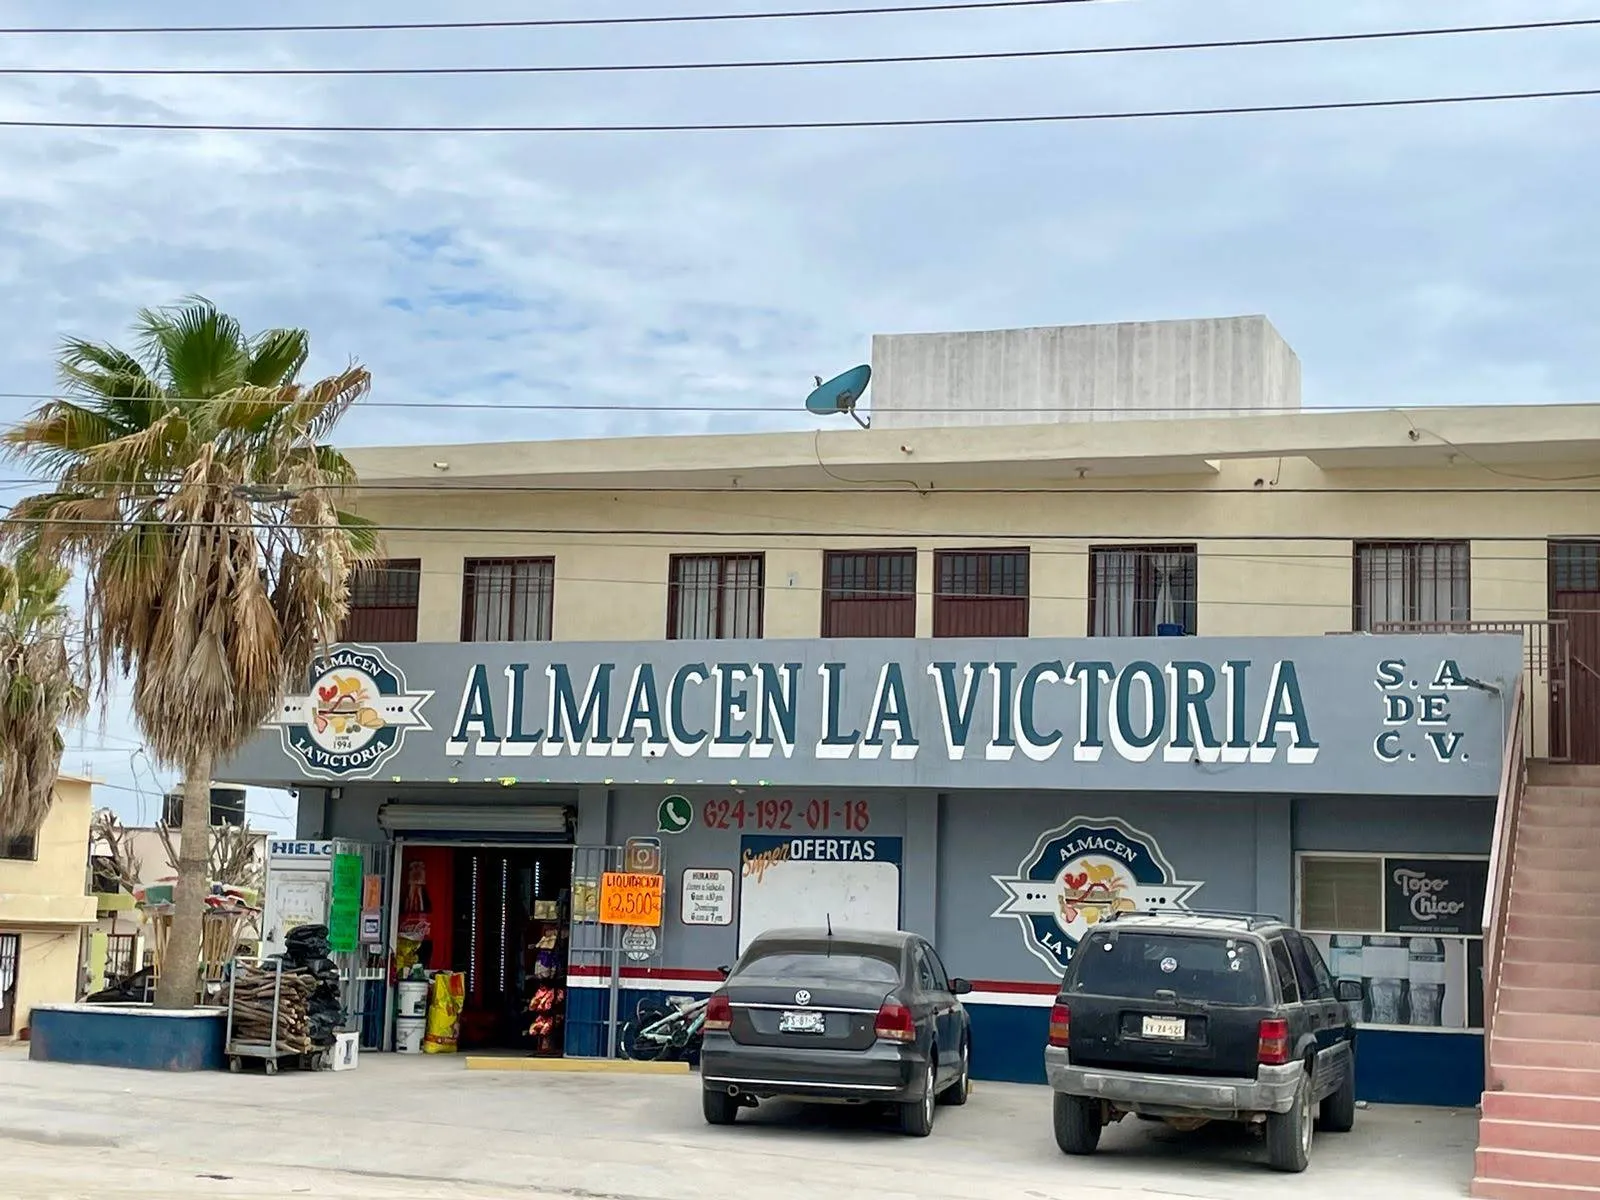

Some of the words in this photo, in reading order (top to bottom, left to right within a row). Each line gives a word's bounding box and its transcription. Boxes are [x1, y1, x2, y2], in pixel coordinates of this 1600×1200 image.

[314, 654, 382, 678] ALMACEN
[446, 662, 803, 758] ALMACEN
[815, 662, 919, 761] LA
[927, 660, 1319, 764] VICTORIA
[1383, 693, 1451, 725] DE
[295, 738, 313, 759] LA
[316, 740, 388, 767] VICTORIA
[790, 839, 876, 861] OFERTAS
[1059, 836, 1137, 862] ALMACEN
[1394, 868, 1448, 896] Topo
[1410, 892, 1464, 921] Chico
[1041, 932, 1063, 955] LA
